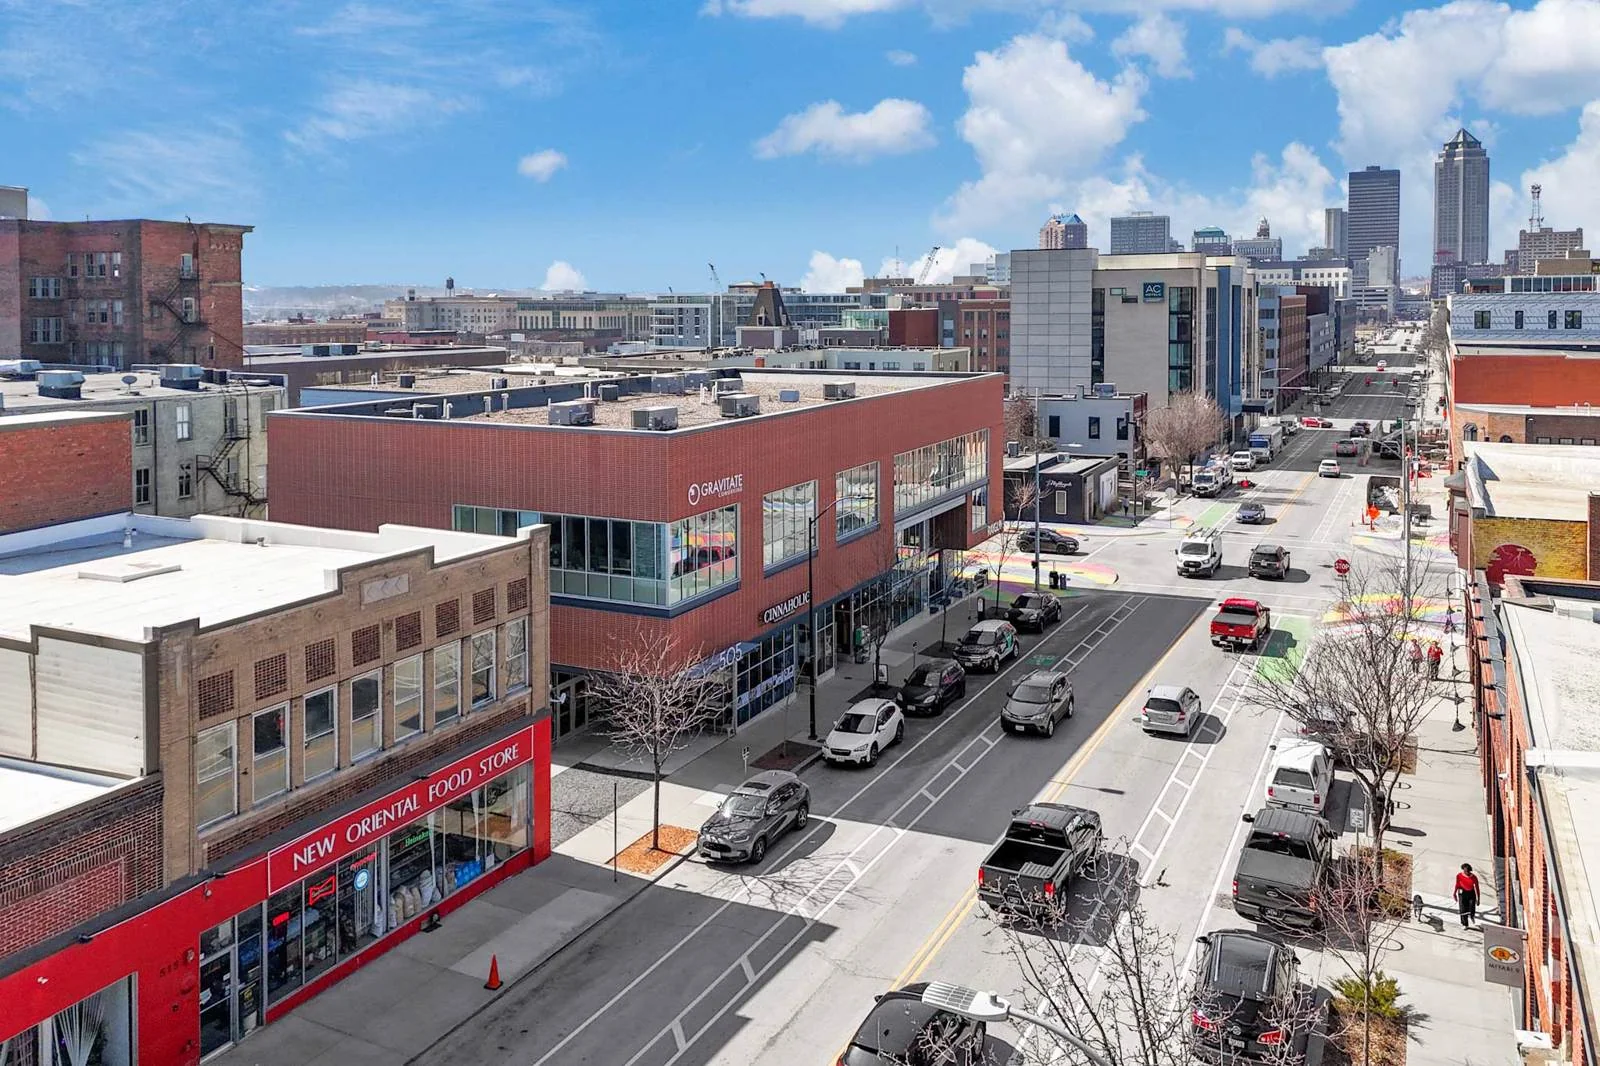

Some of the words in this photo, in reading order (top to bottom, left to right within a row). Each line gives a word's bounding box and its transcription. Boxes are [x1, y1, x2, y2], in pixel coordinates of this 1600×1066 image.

[1145, 284, 1161, 293] AC
[701, 473, 743, 497] GRAVITATE
[1335, 562, 1350, 570] STOP
[763, 590, 811, 624] CINNAHOLIC
[719, 641, 743, 670] 505
[293, 833, 337, 872] NEW
[346, 793, 421, 843] ORIENTAL
[428, 767, 472, 803] FOOD
[479, 743, 519, 777] STORE
